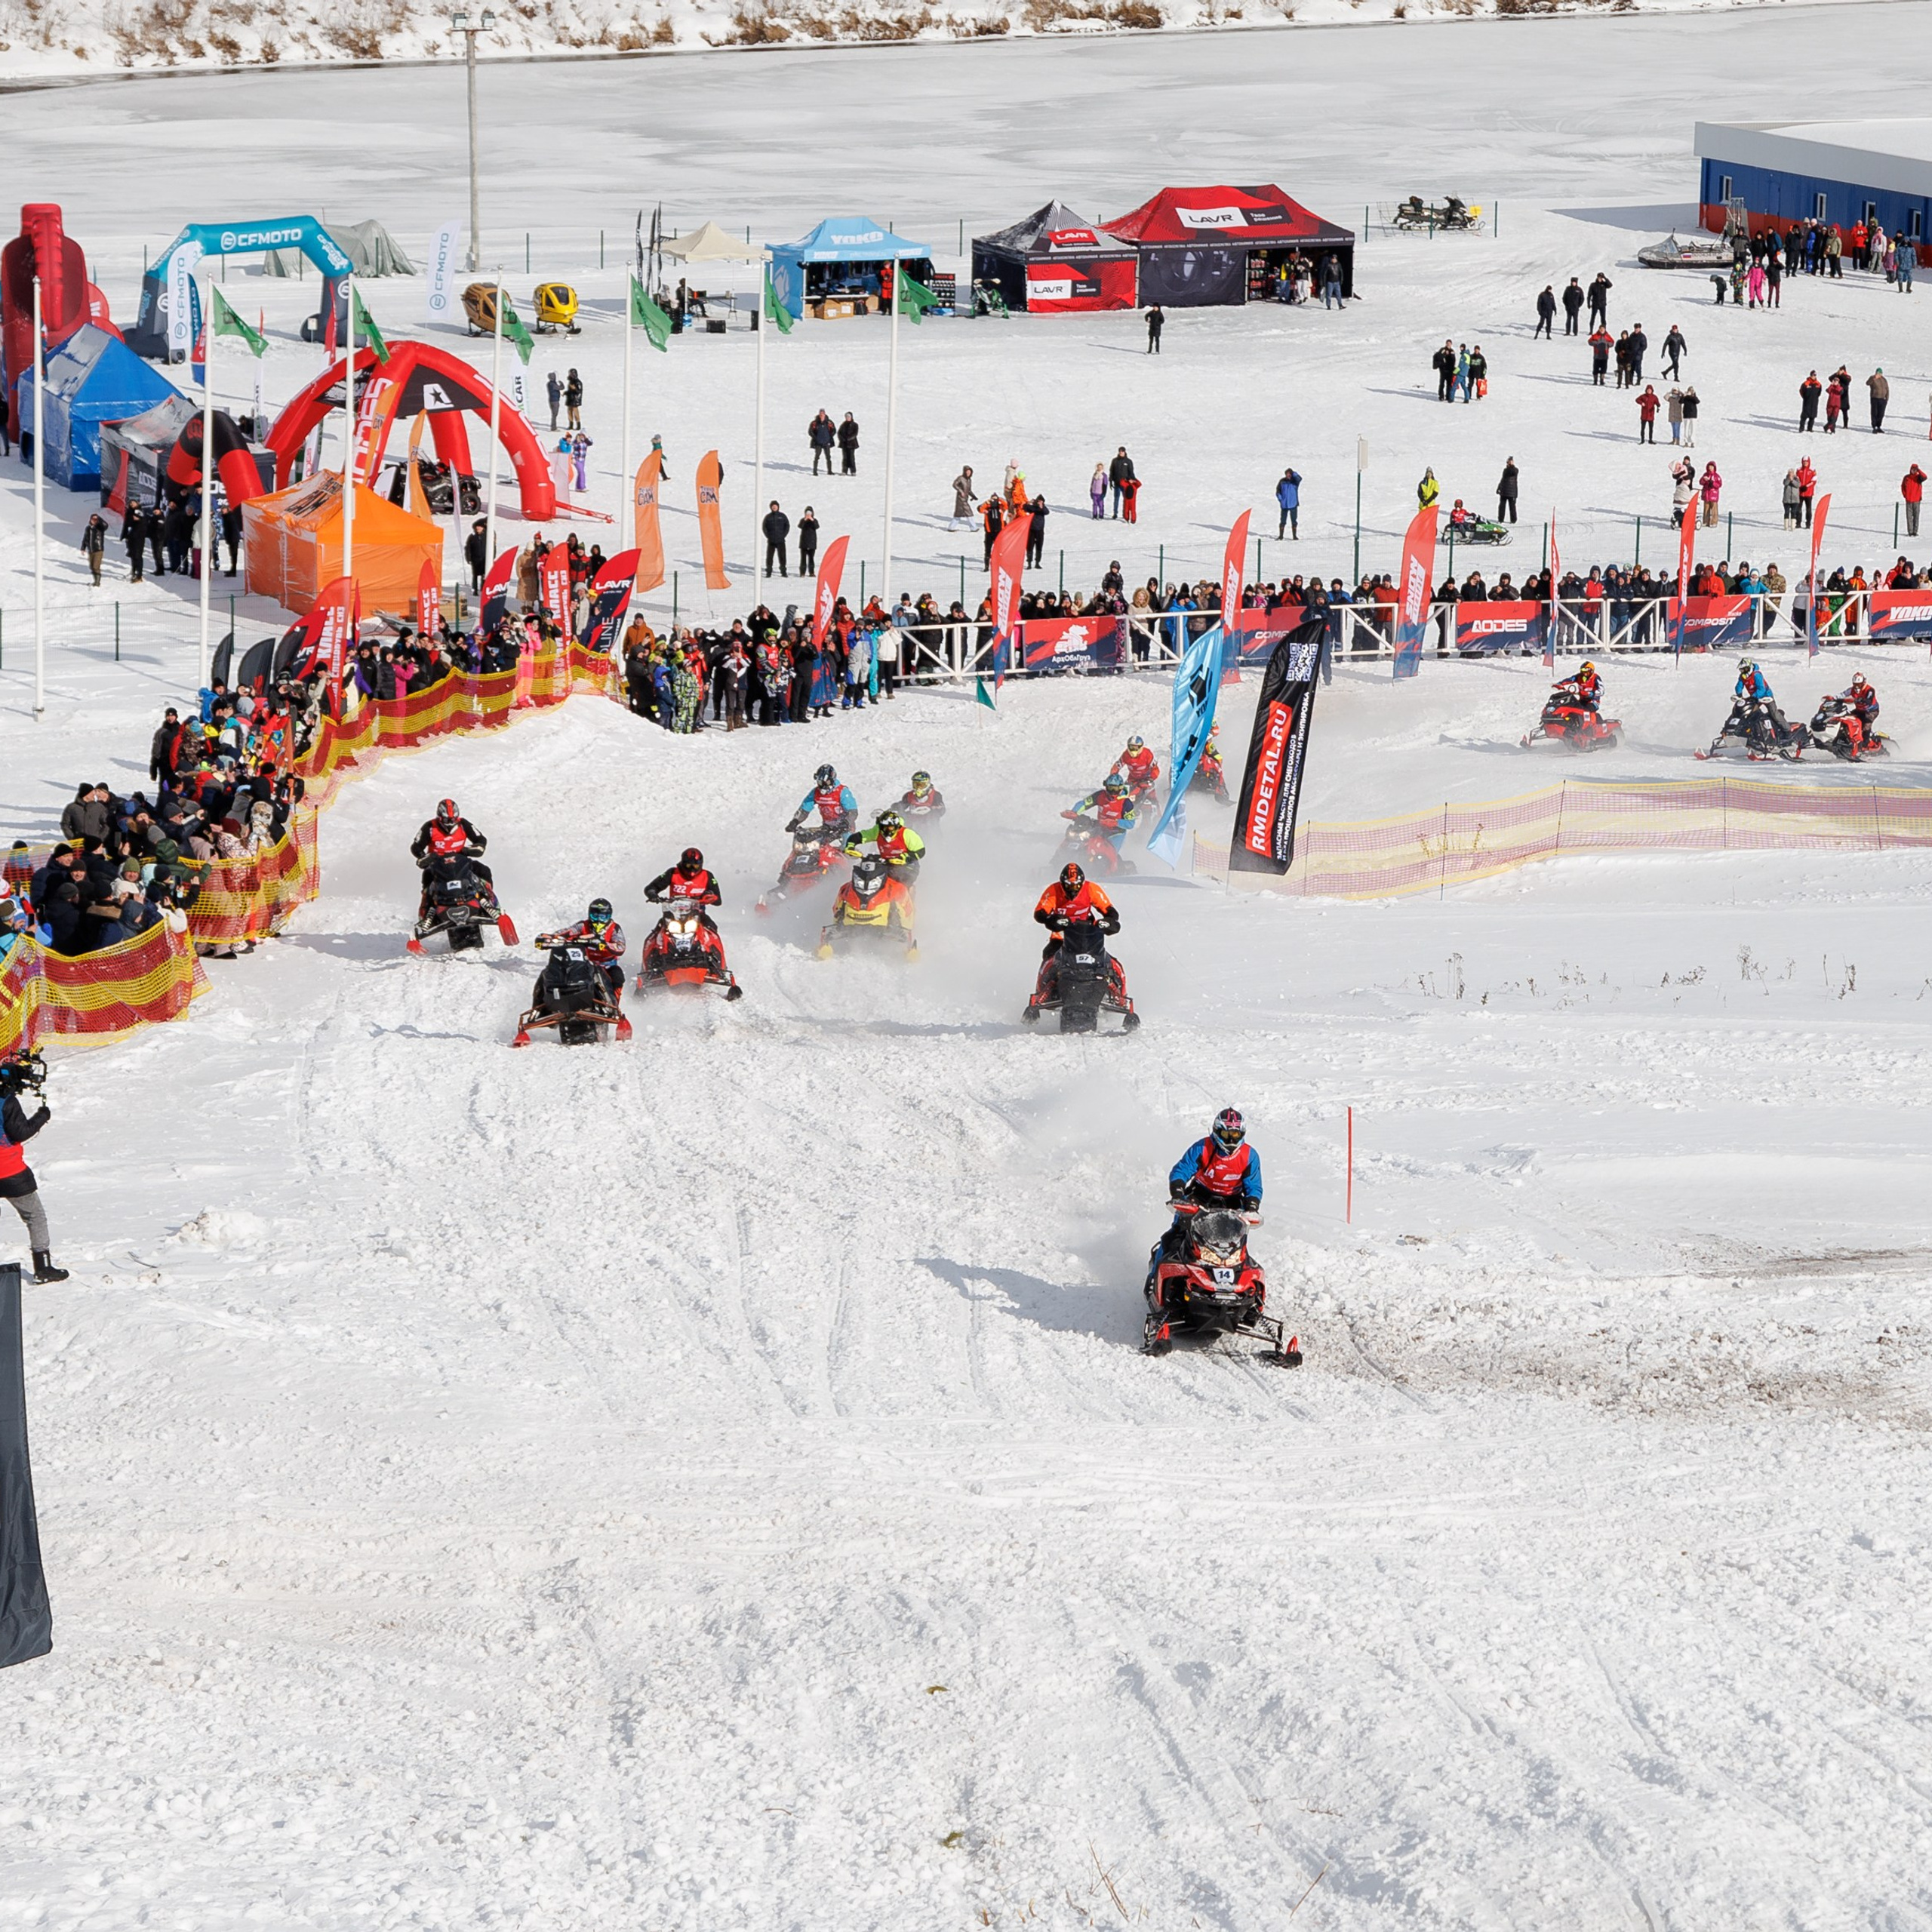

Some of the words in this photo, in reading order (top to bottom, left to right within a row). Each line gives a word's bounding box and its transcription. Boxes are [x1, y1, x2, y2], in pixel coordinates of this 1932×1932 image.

[1189, 214, 1232, 223] LAVR
[237, 228, 302, 247] CFMOTO
[830, 231, 884, 245] YOKO
[435, 232, 448, 291] CFMOTO
[595, 580, 631, 590] LAVR
[1406, 553, 1418, 620] SNOW
[1472, 619, 1527, 632] AODES
[1051, 654, 1091, 663] АрхОблГруз
[1297, 691, 1309, 742] ЭКИПИРОВКА
[1252, 709, 1287, 851] RMDETAL.RU
[1278, 798, 1287, 821] ЧАСТИ
[1285, 734, 1297, 783] СНЕГОХОДОВ
[673, 884, 687, 894] 222
[1204, 1169, 1214, 1178] 14
[1218, 1271, 1231, 1279] 14
